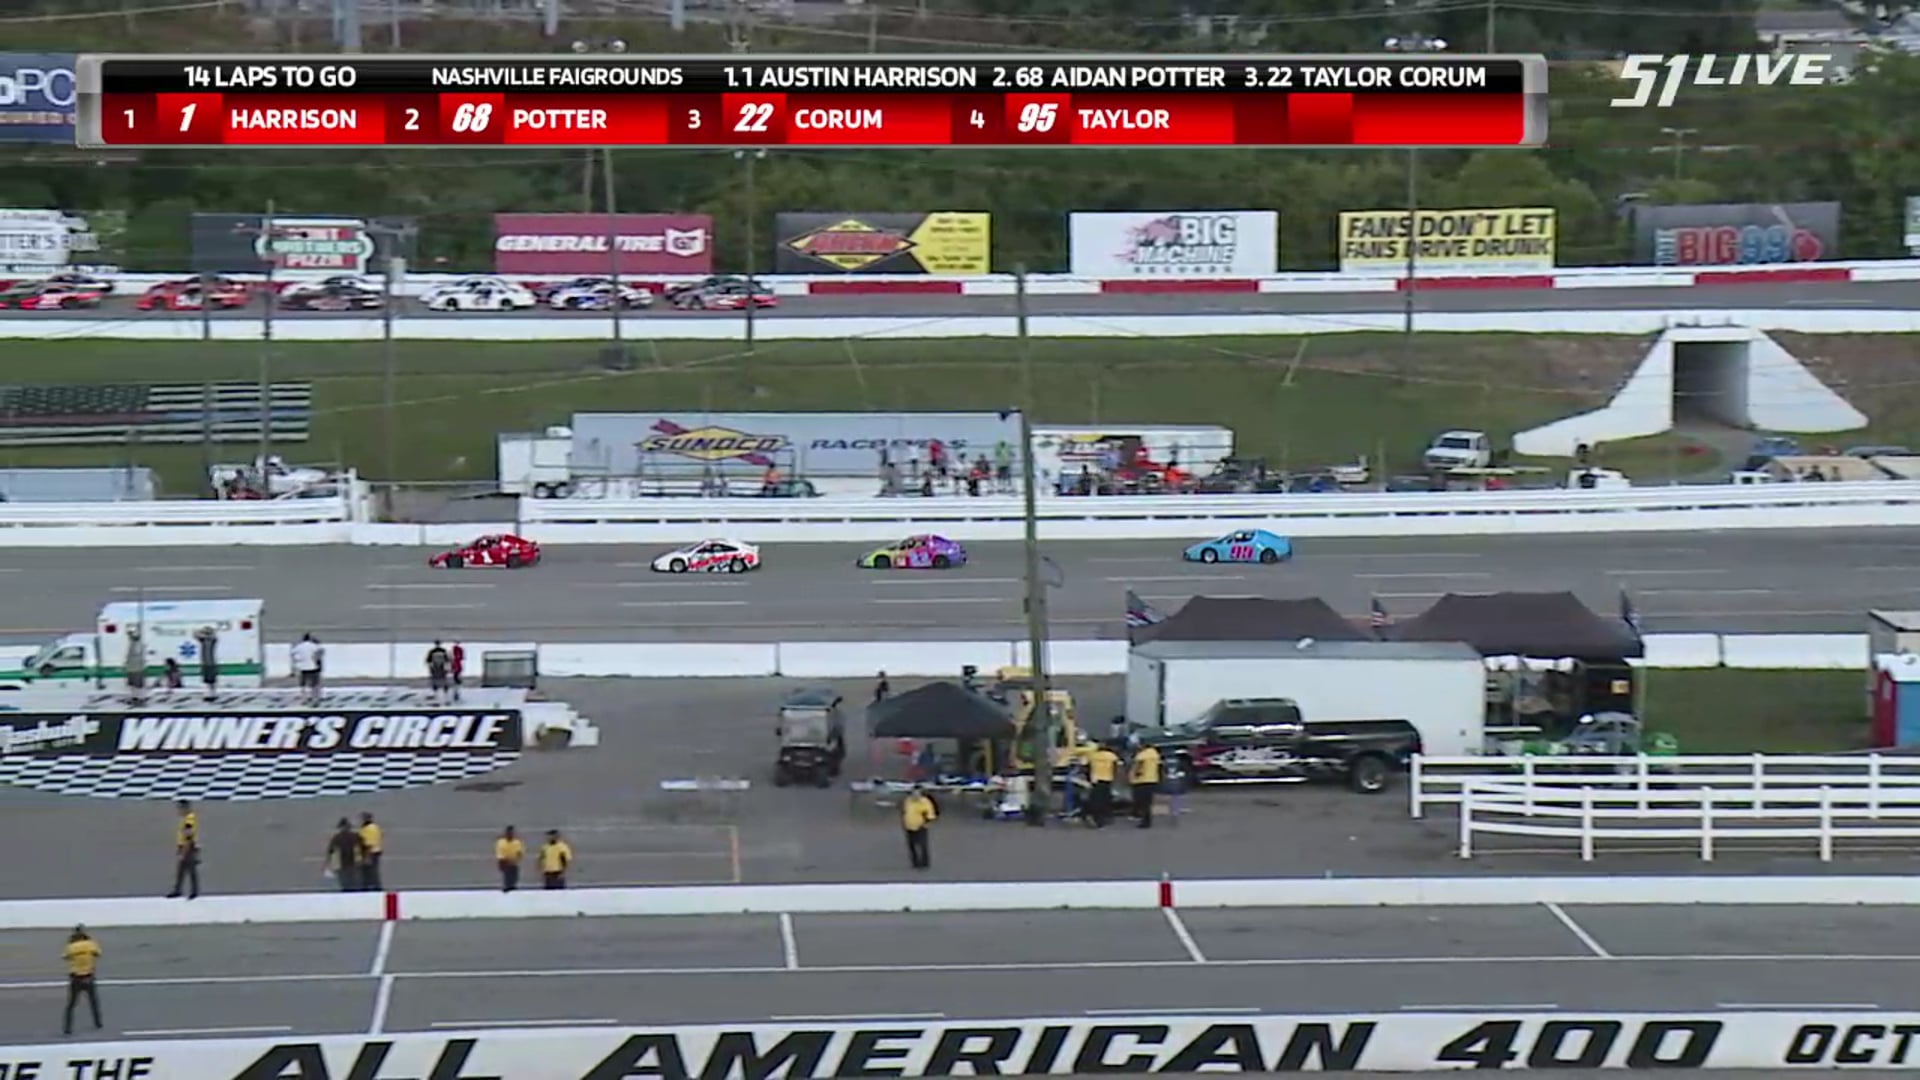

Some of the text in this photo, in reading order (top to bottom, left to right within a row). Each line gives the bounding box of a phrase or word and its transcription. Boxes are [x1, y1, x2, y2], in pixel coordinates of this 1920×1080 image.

[1177, 213, 1236, 246] BIG
[1349, 213, 1551, 239] FANS DON'T LET
[495, 235, 608, 251] GENERAL
[1345, 238, 1550, 259] FANS DRIVE DRUNK
[1677, 226, 1738, 265] BIG
[649, 437, 779, 451] SUNOCO
[117, 716, 346, 751] WINNER'S
[349, 715, 510, 749] CIRCLE
[230, 1036, 502, 1080] ALL
[577, 1019, 1379, 1080] AMERICAN
[1435, 1020, 1724, 1068] 400
[1783, 1024, 1920, 1065] OCT
